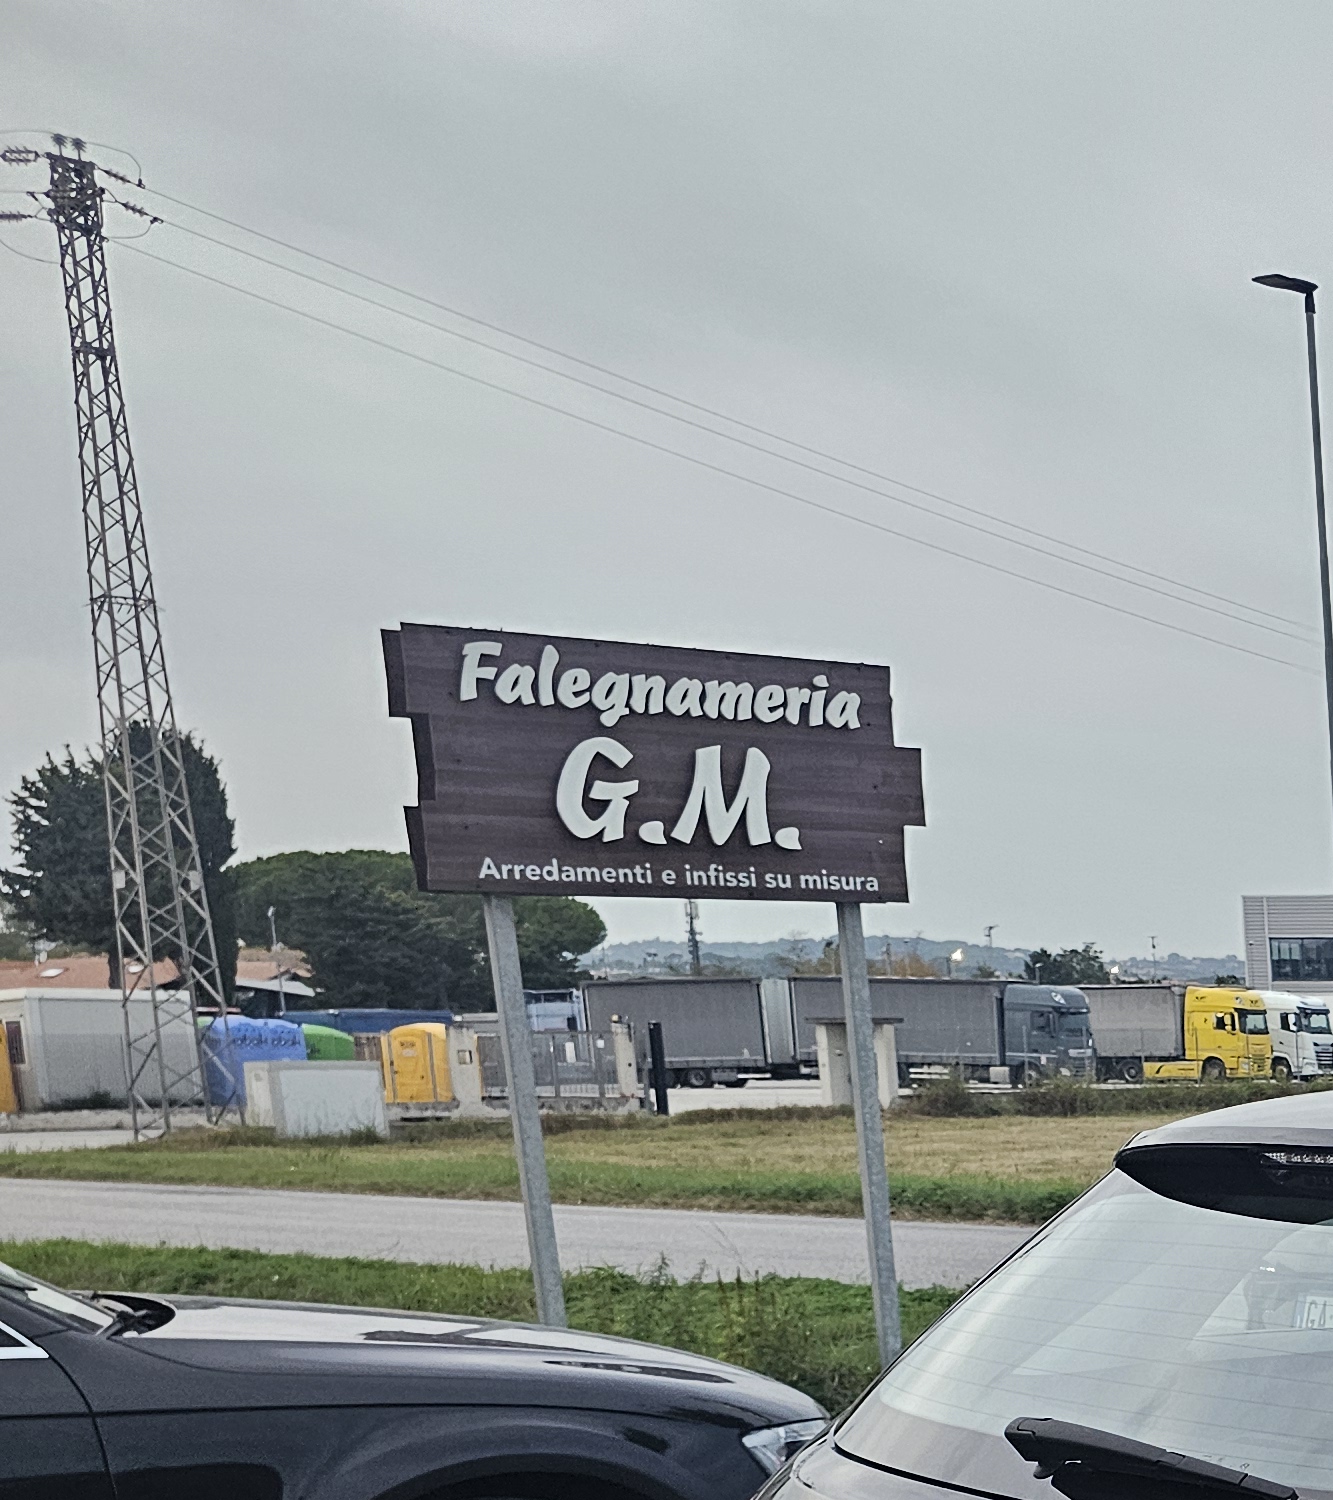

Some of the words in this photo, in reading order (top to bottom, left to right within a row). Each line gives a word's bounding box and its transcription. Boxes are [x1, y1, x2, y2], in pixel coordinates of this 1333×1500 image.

[459, 640, 862, 730] Falegnameria
[555, 736, 803, 850] G.M.
[479, 856, 653, 887] Arredamenti
[661, 867, 677, 886] e
[685, 863, 758, 889] infissi
[764, 869, 792, 890] su
[800, 868, 880, 893] misura
